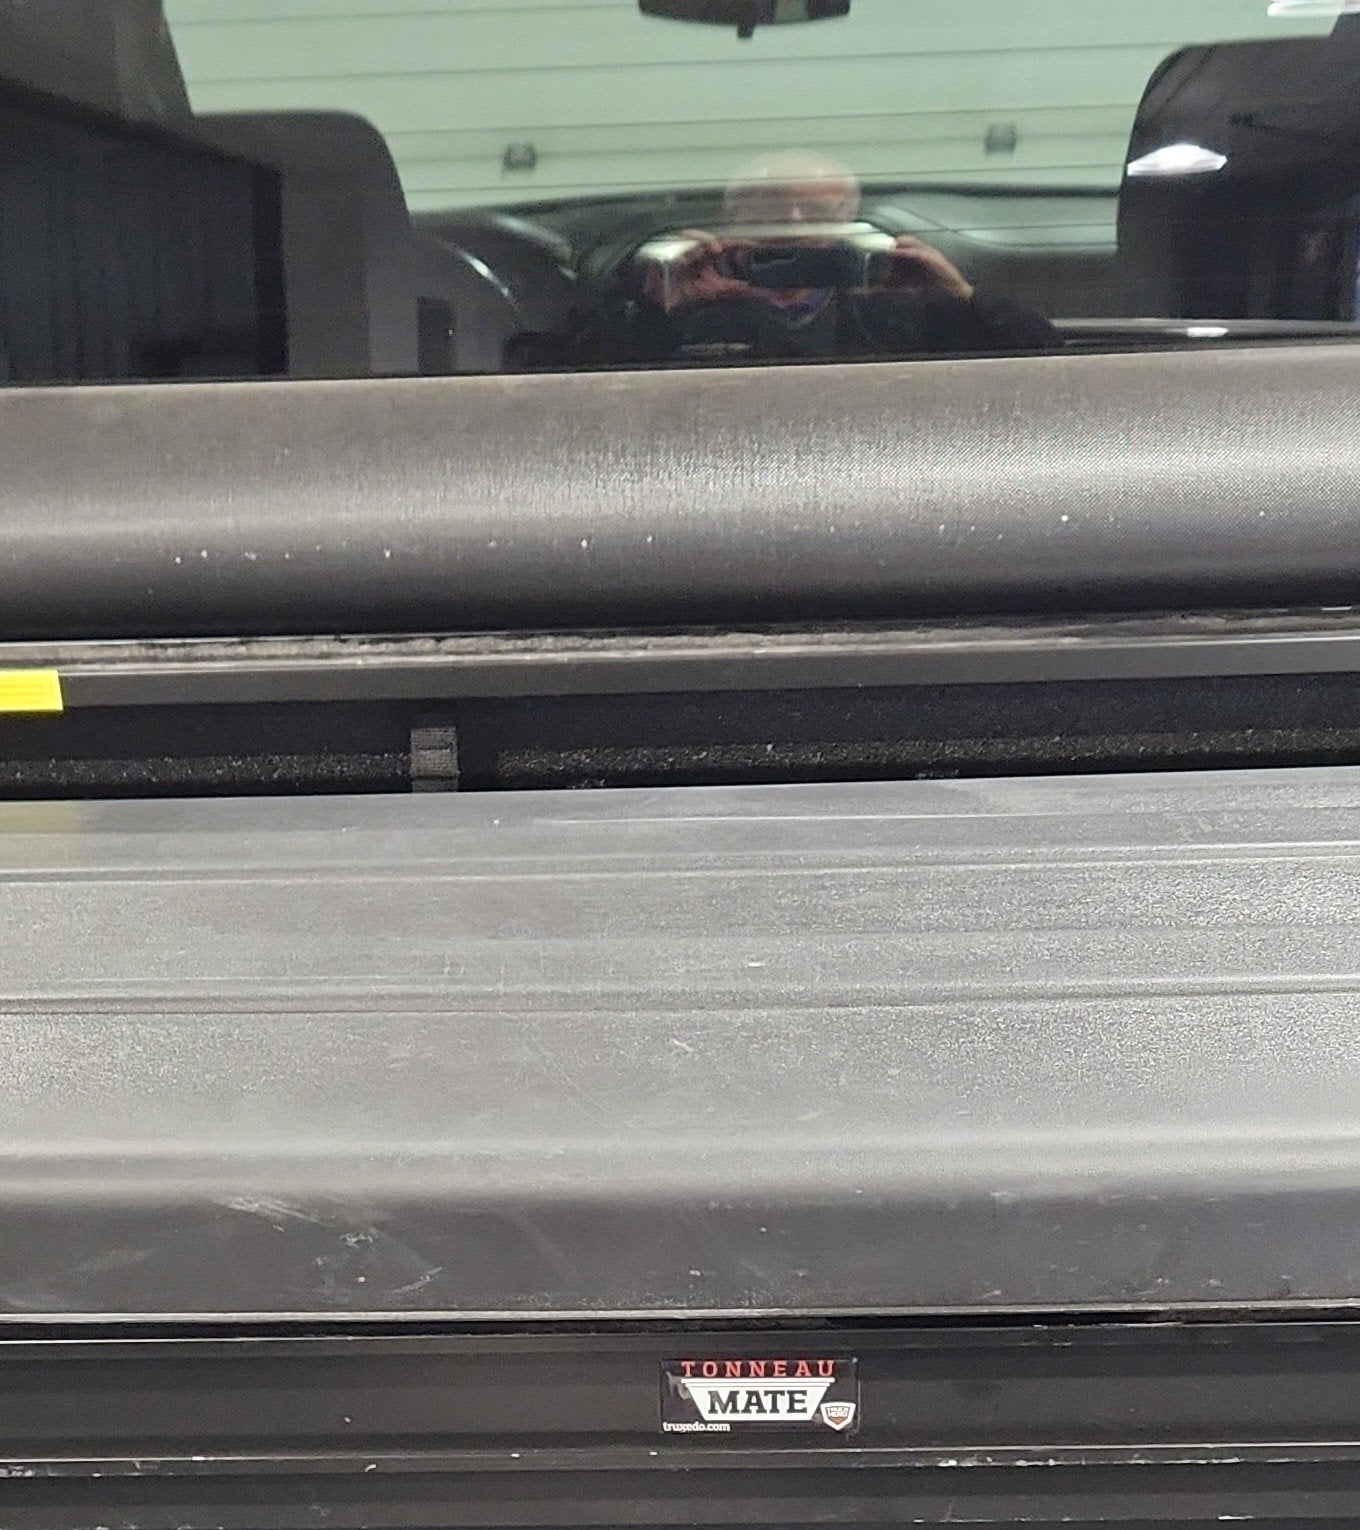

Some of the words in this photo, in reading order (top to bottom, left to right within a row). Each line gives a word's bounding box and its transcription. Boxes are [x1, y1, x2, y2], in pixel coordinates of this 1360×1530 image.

[681, 1360, 834, 1378] TONNEAU
[707, 1389, 808, 1414] MATE
[662, 1421, 731, 1432] truxedo.com
